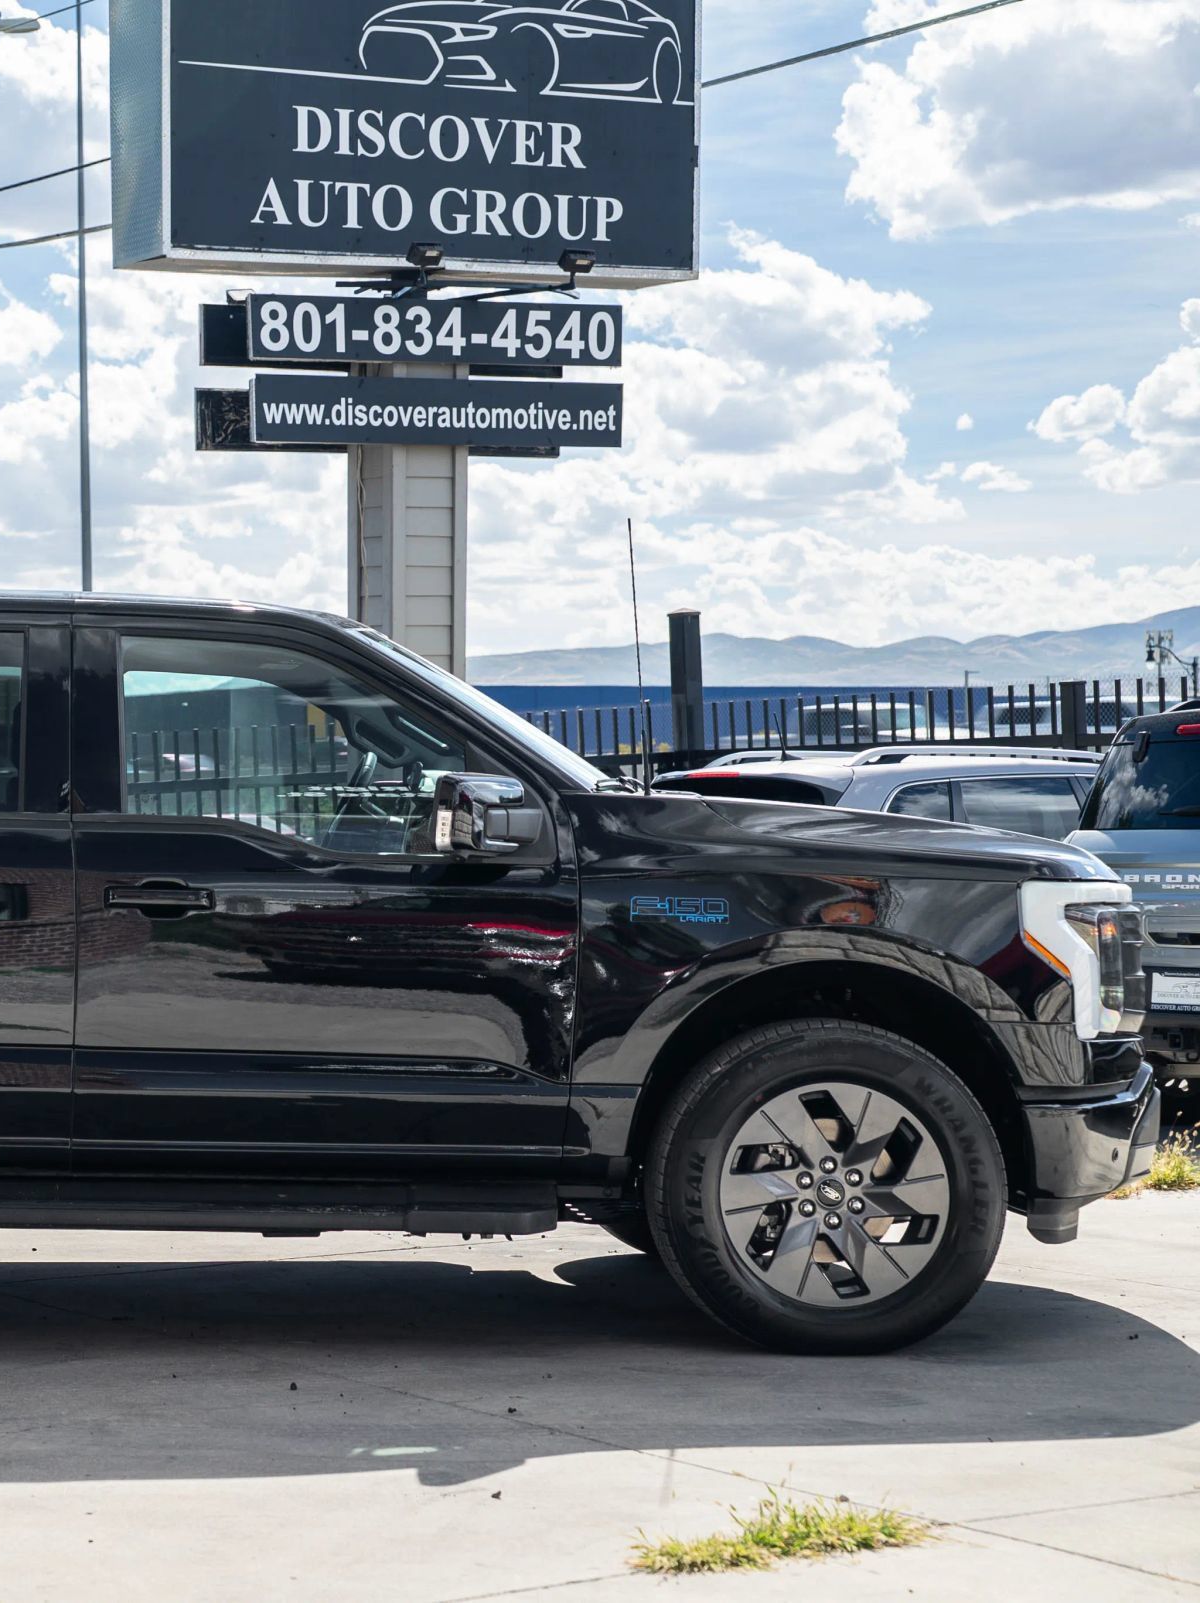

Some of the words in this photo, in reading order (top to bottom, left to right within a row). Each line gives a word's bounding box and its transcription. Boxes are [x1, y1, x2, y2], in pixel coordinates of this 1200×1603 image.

[293, 106, 587, 169] DISCOVER
[251, 178, 413, 232] AUTO
[429, 188, 624, 242] GROUP
[260, 301, 616, 361] 801-834-4540
[262, 397, 617, 431] www.discoverautomotive.net
[630, 896, 729, 918] F-150
[679, 915, 725, 923] LARIAT
